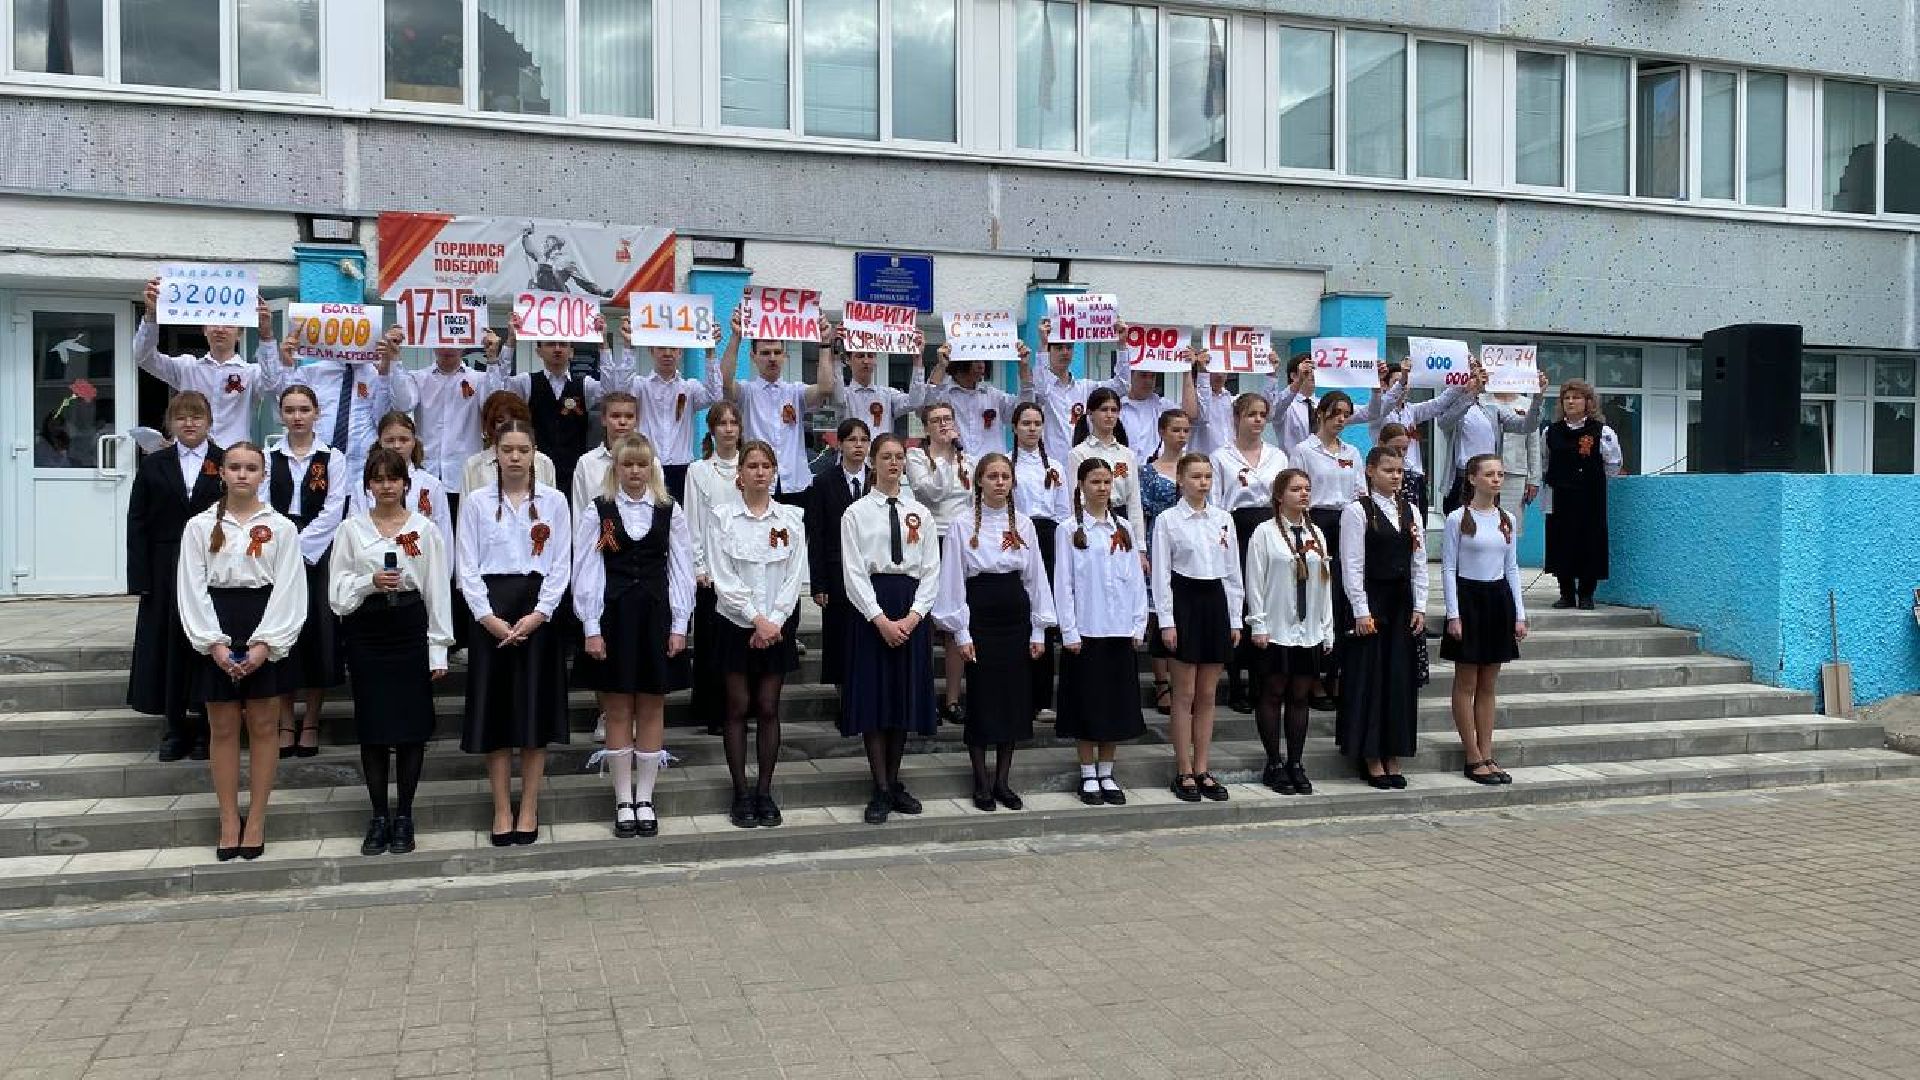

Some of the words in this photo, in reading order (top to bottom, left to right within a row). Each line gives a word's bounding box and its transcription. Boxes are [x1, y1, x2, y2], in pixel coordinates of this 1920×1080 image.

[434, 241, 505, 258] ГОРДИМСЯ
[434, 258, 499, 274] ПОБЕДОЙ!
[321, 303, 365, 315] БОЛЕЕ
[518, 294, 585, 337] 2600
[640, 303, 710, 334] 1418
[845, 302, 915, 326] ПОДВИГИ
[759, 315, 819, 338] ЛИНА
[1127, 326, 1178, 365] 900
[1209, 324, 1254, 372] 45
[1241, 333, 1265, 346] ЛЕТ
[1314, 347, 1348, 368] 27
